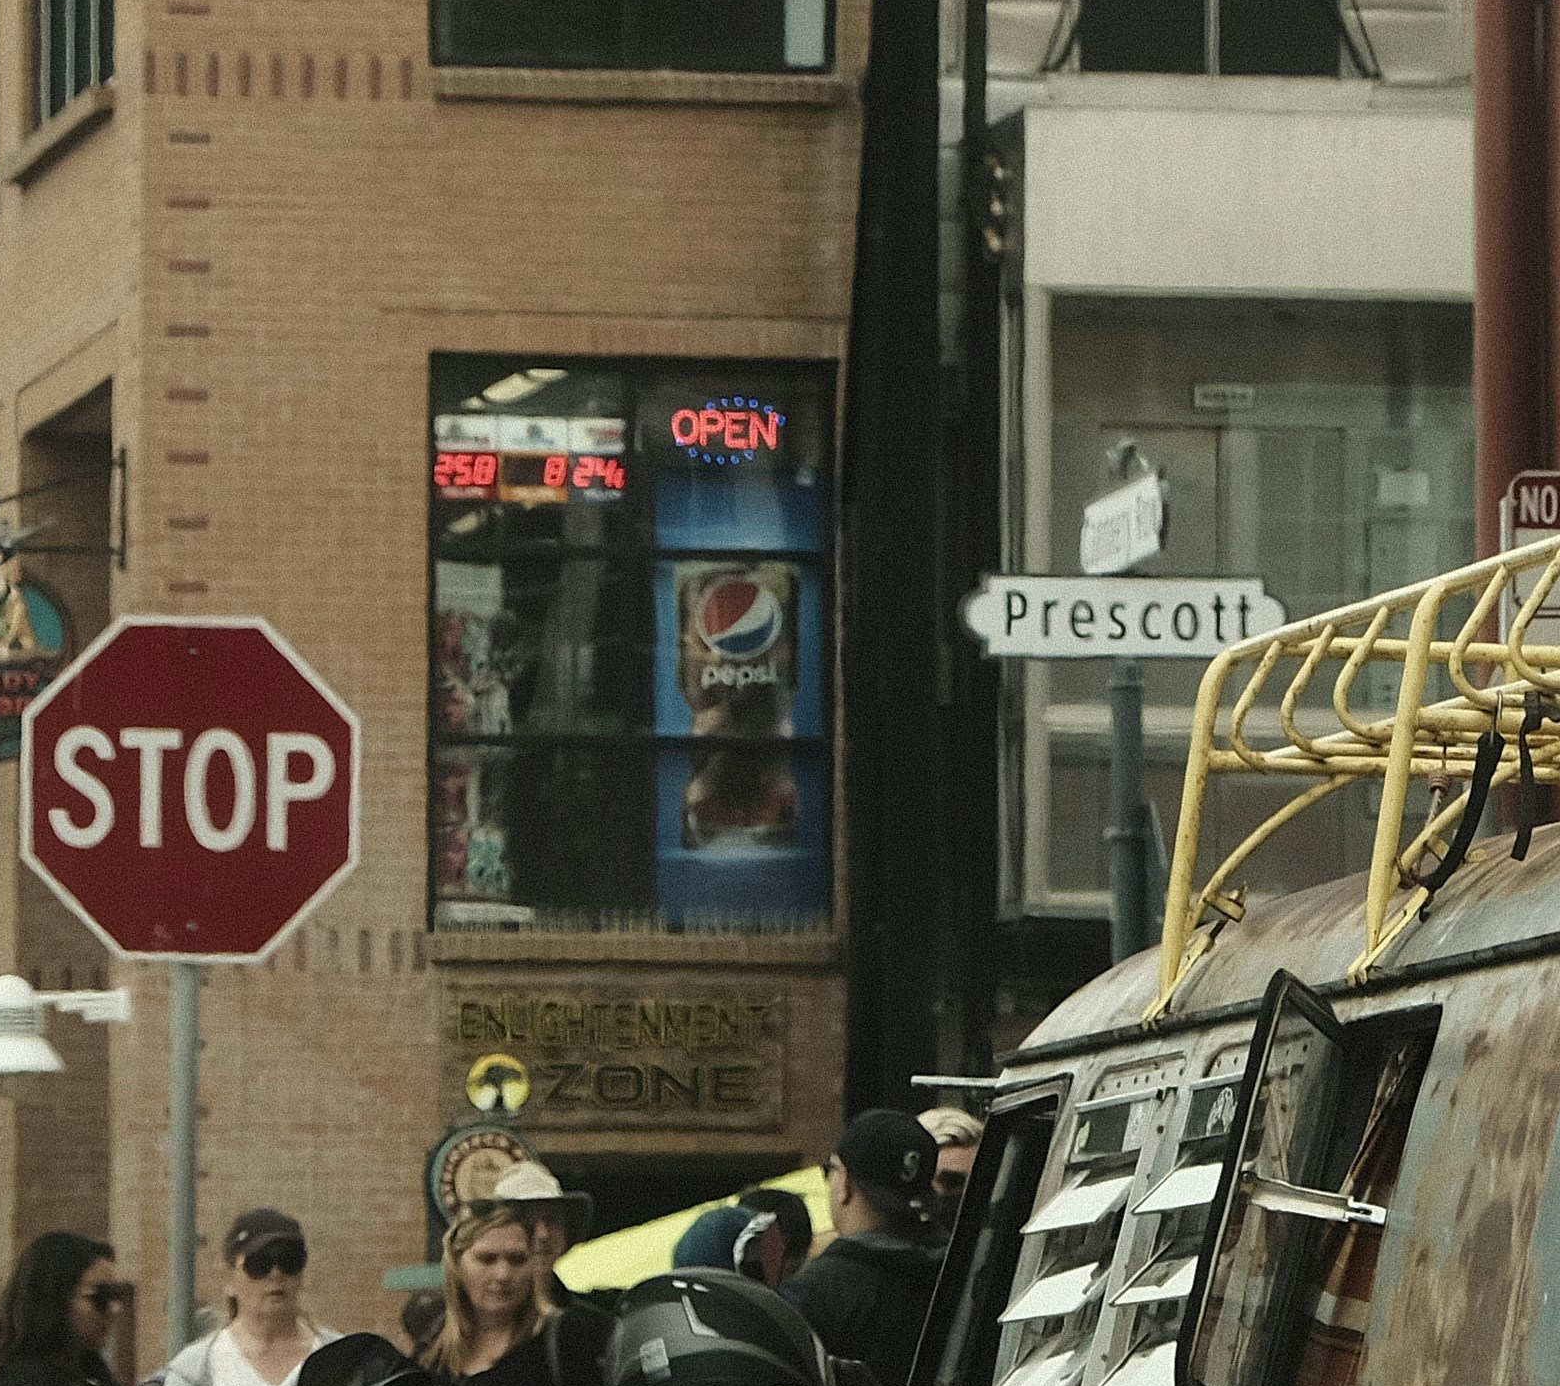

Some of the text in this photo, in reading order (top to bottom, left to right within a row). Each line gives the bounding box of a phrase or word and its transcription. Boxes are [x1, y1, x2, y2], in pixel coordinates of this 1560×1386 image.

[671, 407, 779, 451] OPEN
[1520, 485, 1558, 525] NO
[1005, 590, 1252, 644] Prescott
[700, 663, 778, 688] pepsi
[48, 725, 336, 853] STOP
[545, 1063, 758, 1108] ZONE
